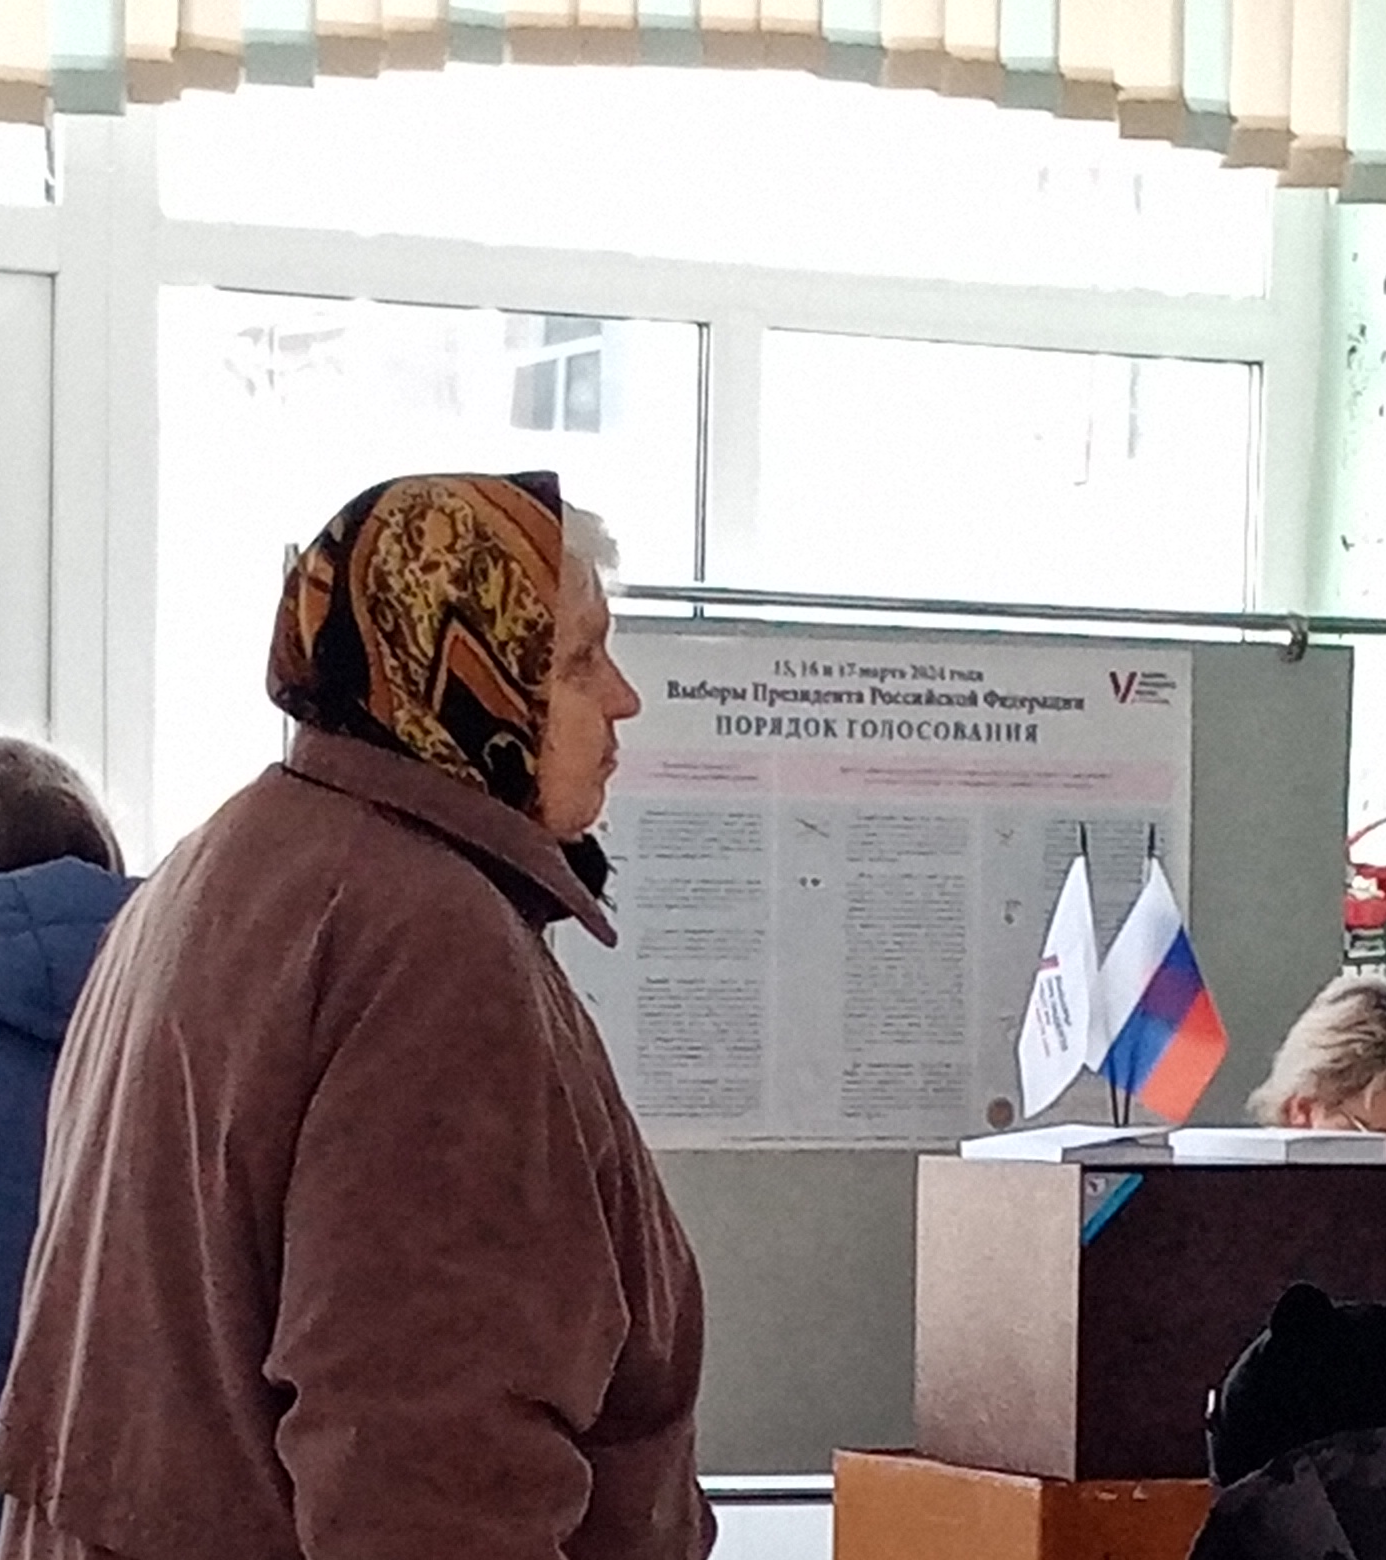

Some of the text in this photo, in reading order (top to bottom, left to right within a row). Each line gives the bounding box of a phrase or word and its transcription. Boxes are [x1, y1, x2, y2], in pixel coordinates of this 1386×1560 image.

[667, 680, 747, 706] Выборы
[753, 682, 864, 708] Президента
[869, 685, 978, 708] Российской
[716, 714, 1039, 745] ПОРЯДОК ГОЛОСОВАНИЯ
